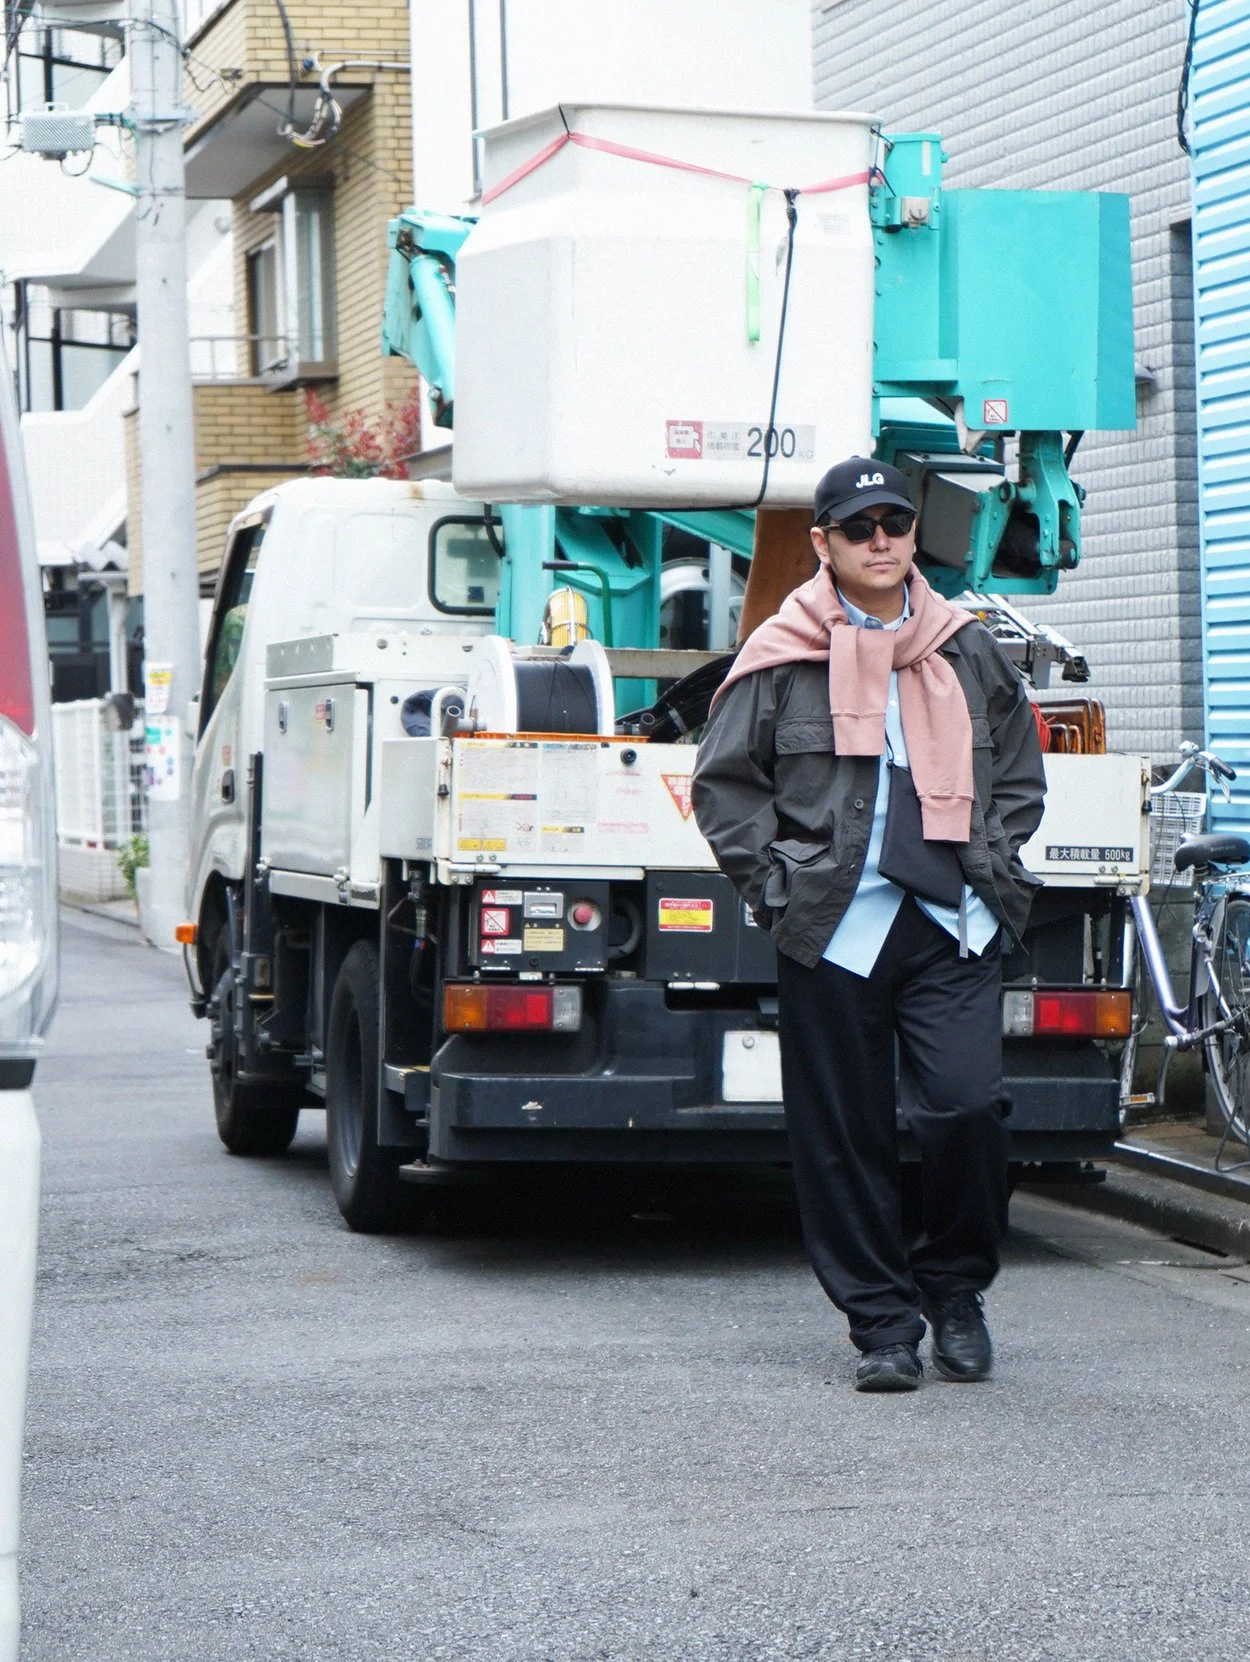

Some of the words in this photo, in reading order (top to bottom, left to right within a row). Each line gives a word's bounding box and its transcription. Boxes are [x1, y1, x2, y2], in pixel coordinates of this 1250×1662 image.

[747, 427, 796, 458] 200
[855, 472, 885, 488] JLG
[1049, 847, 1101, 861] 最大積載量
[1104, 849, 1131, 862] 500kg
